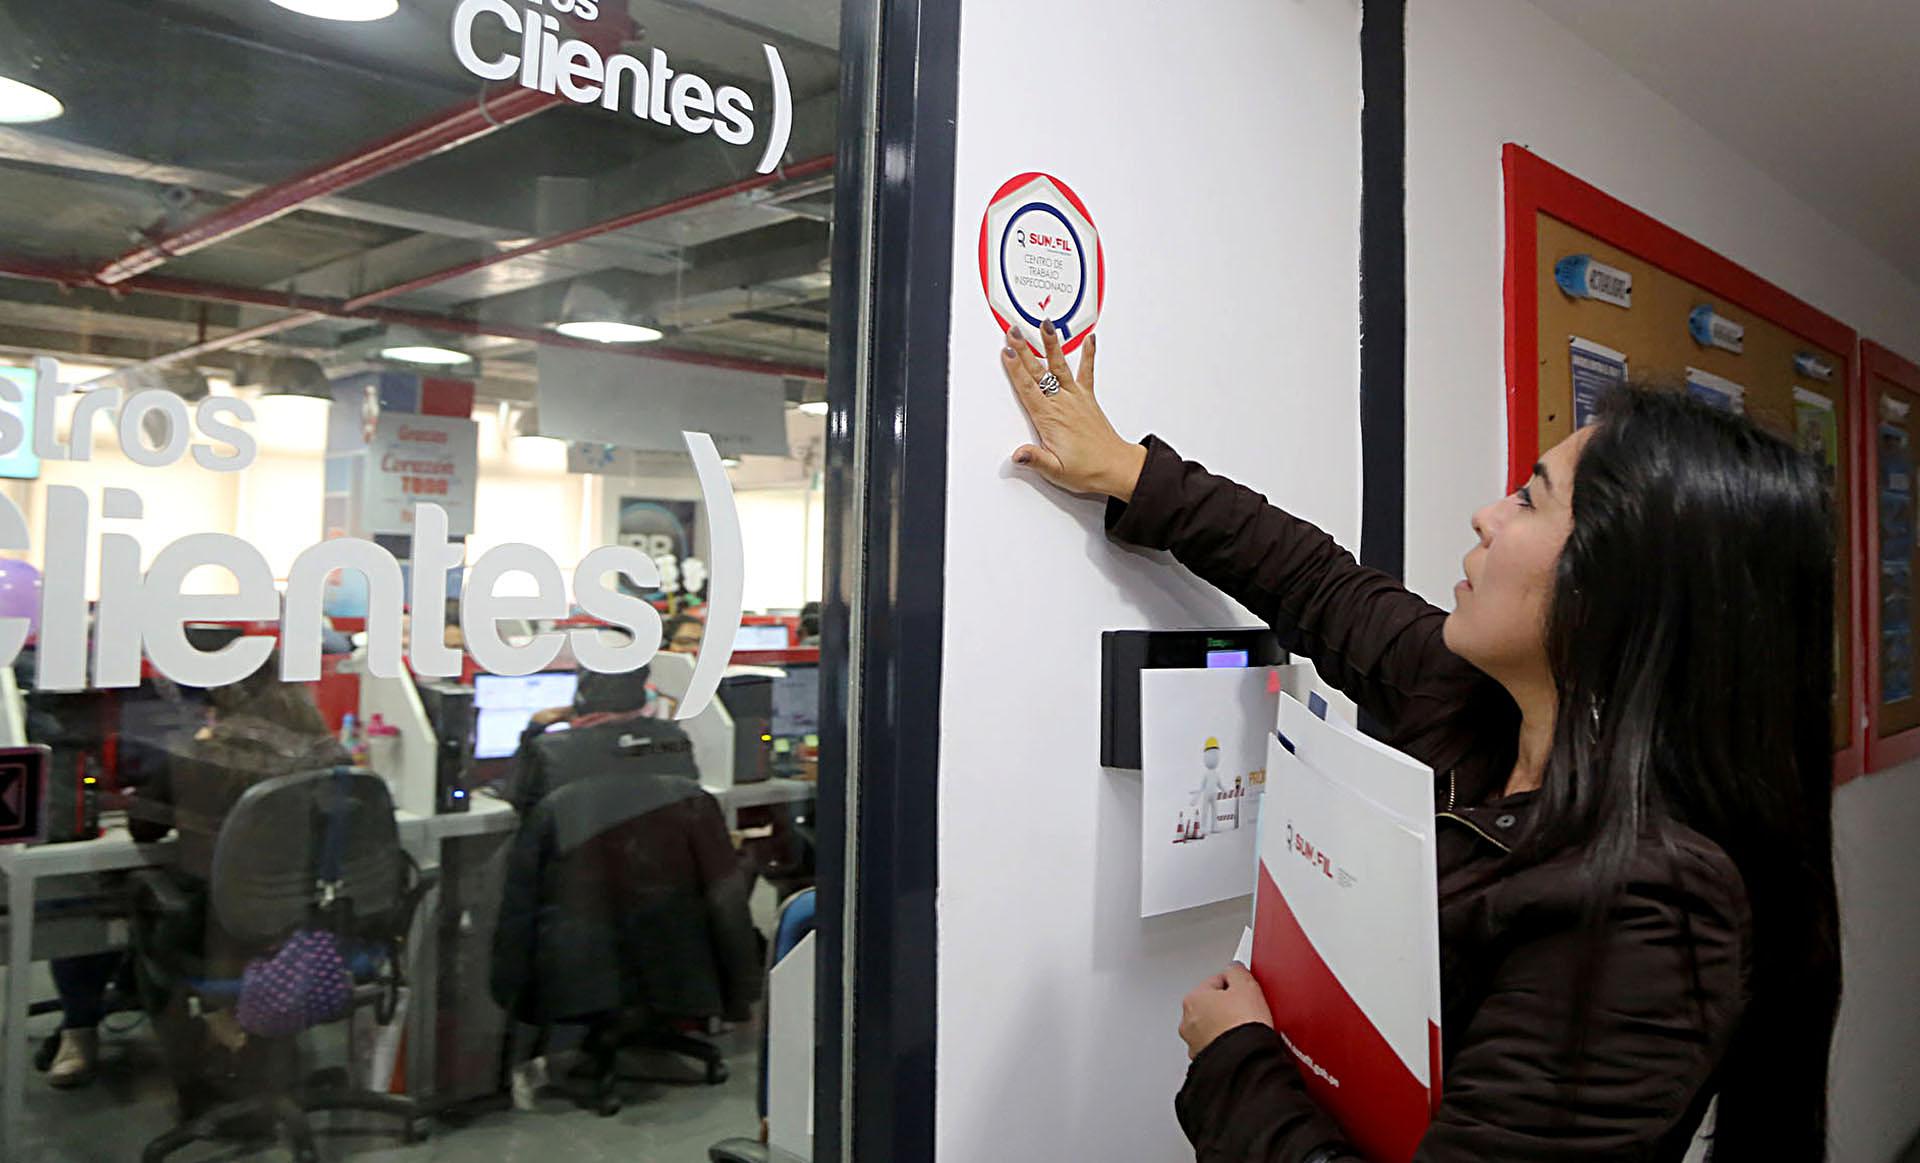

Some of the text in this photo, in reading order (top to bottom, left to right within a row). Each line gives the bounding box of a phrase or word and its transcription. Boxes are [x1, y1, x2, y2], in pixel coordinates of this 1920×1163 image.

[1025, 254, 1064, 270] CENTRO DE
[1029, 266, 1059, 280] TRABAJO
[1015, 275, 1073, 293] INSPECCIONADO
